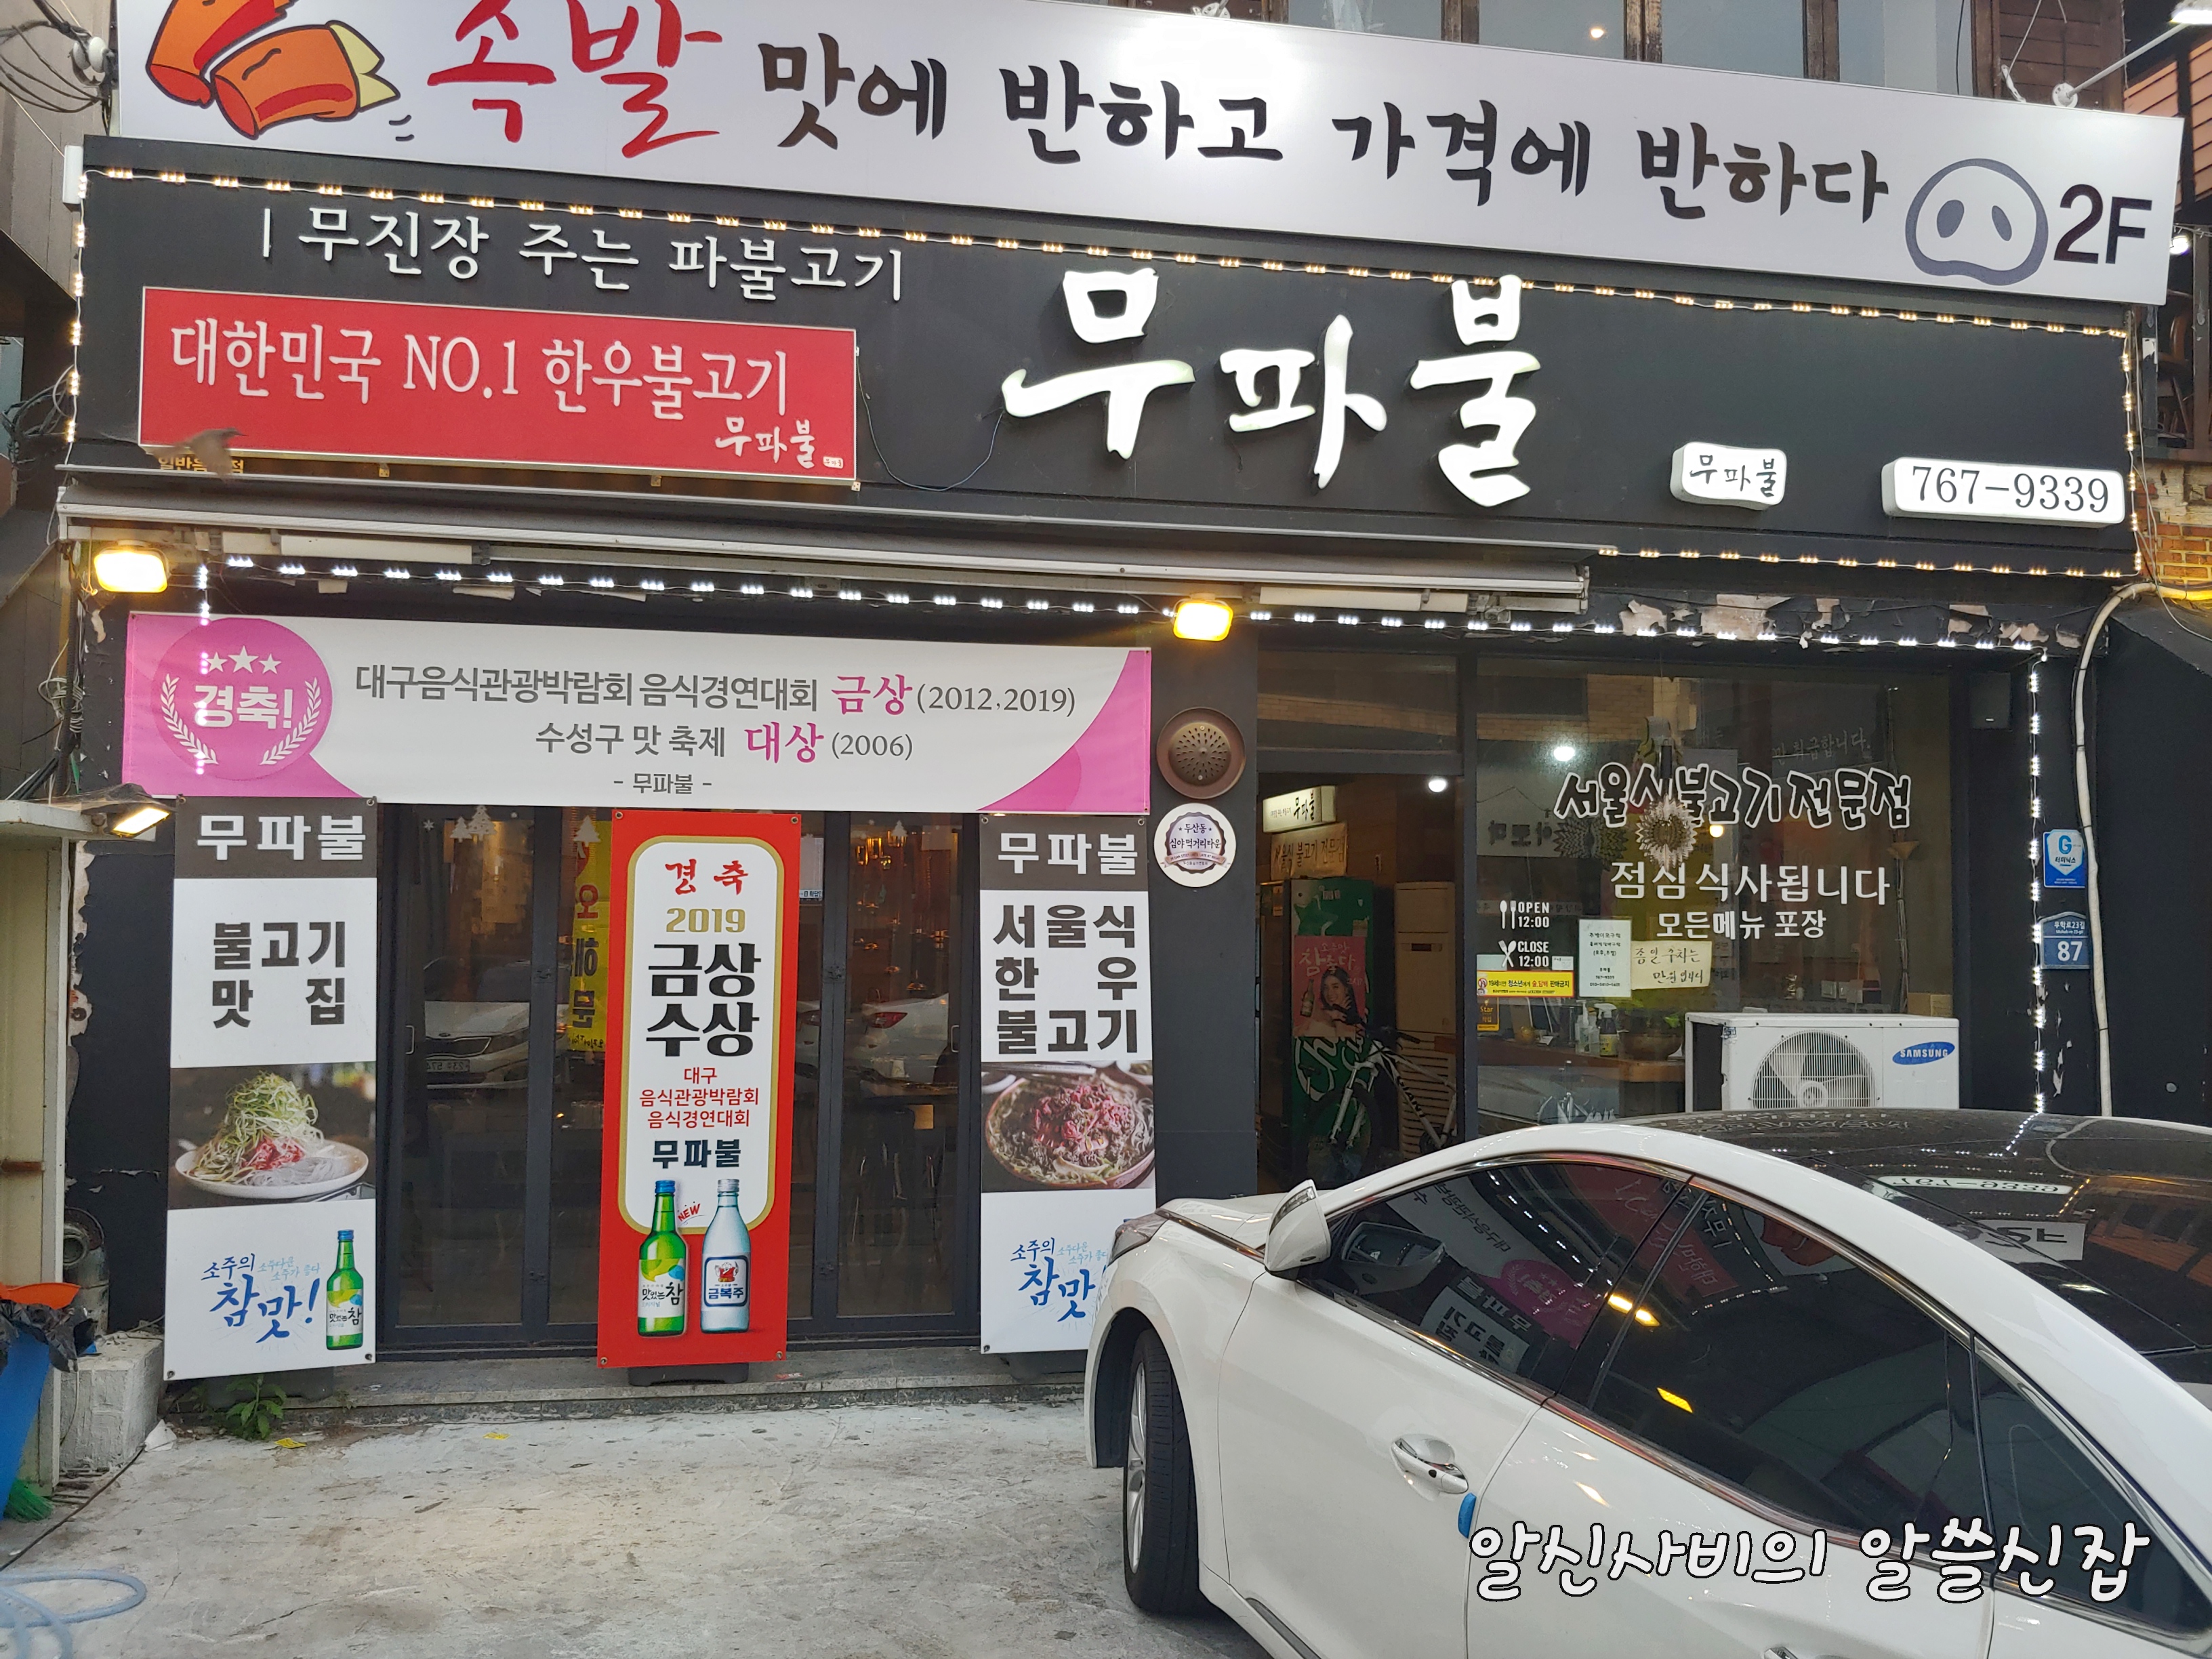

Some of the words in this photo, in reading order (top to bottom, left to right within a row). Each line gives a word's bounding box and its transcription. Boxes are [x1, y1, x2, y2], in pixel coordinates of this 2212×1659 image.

[758, 33, 947, 150] 맛에
[999, 60, 1283, 165] 반하고
[1331, 99, 1590, 207] 가격에
[1637, 122, 1889, 224] 반하다
[2053, 184, 2152, 264] 2F
[299, 207, 489, 279] 무진장
[519, 224, 639, 290] 주는
[669, 236, 901, 301] 파불고기
[171, 318, 381, 404] 대한민국
[404, 335, 518, 398] NO.1
[542, 340, 786, 420] 한우불고기
[1001, 268, 1540, 507] 무파불
[715, 417, 816, 468] 무파불
[159, 457, 243, 473] 일반음점
[1689, 454, 1778, 498] 무파불
[1912, 466, 2109, 513] 767-9339
[356, 663, 633, 705] 대구음식관광박람회
[639, 672, 817, 712] 음식경연대회
[194, 684, 292, 729] 경축!
[536, 722, 623, 754] 수성구
[634, 724, 661, 756] 맛
[668, 725, 725, 758] 축제
[745, 721, 824, 764] 대상
[832, 733, 913, 761] (2006)
[1294, 790, 1315, 821] 무파불
[197, 815, 365, 860] 무파불
[1184, 823, 1207, 834] 두산동
[998, 833, 1138, 875] 무파불
[1296, 840, 1317, 867] 불고기
[1321, 836, 1345, 863] 전문점
[666, 908, 746, 933] 2019
[1518, 901, 1550, 914] OPEN
[1518, 916, 1550, 928] 12:00
[993, 905, 1134, 948] 서울식
[1657, 911, 1765, 940] 모든메뉴
[1775, 909, 1826, 938] 포장
[213, 922, 345, 970] 불고기
[1517, 941, 1549, 953] CLOSE
[1518, 956, 1550, 967] 12:00
[2057, 941, 2083, 962] 87
[648, 943, 761, 998] 금상
[646, 1002, 760, 1057] 수상
[998, 1010, 1137, 1054] 불고기
[1900, 1048, 1948, 1059] SAMSUNG
[684, 1067, 717, 1084] 대구
[639, 1088, 759, 1107] 음식관광박람회
[647, 1109, 750, 1128] 음식경연대회
[653, 1139, 741, 1168] 무파불
[677, 1203, 701, 1222] NEW
[1010, 1237, 1054, 1262] 소주의
[201, 1253, 255, 1281] 소주의
[708, 1287, 744, 1299] 금복주
[210, 1274, 320, 1344] 참맛!
